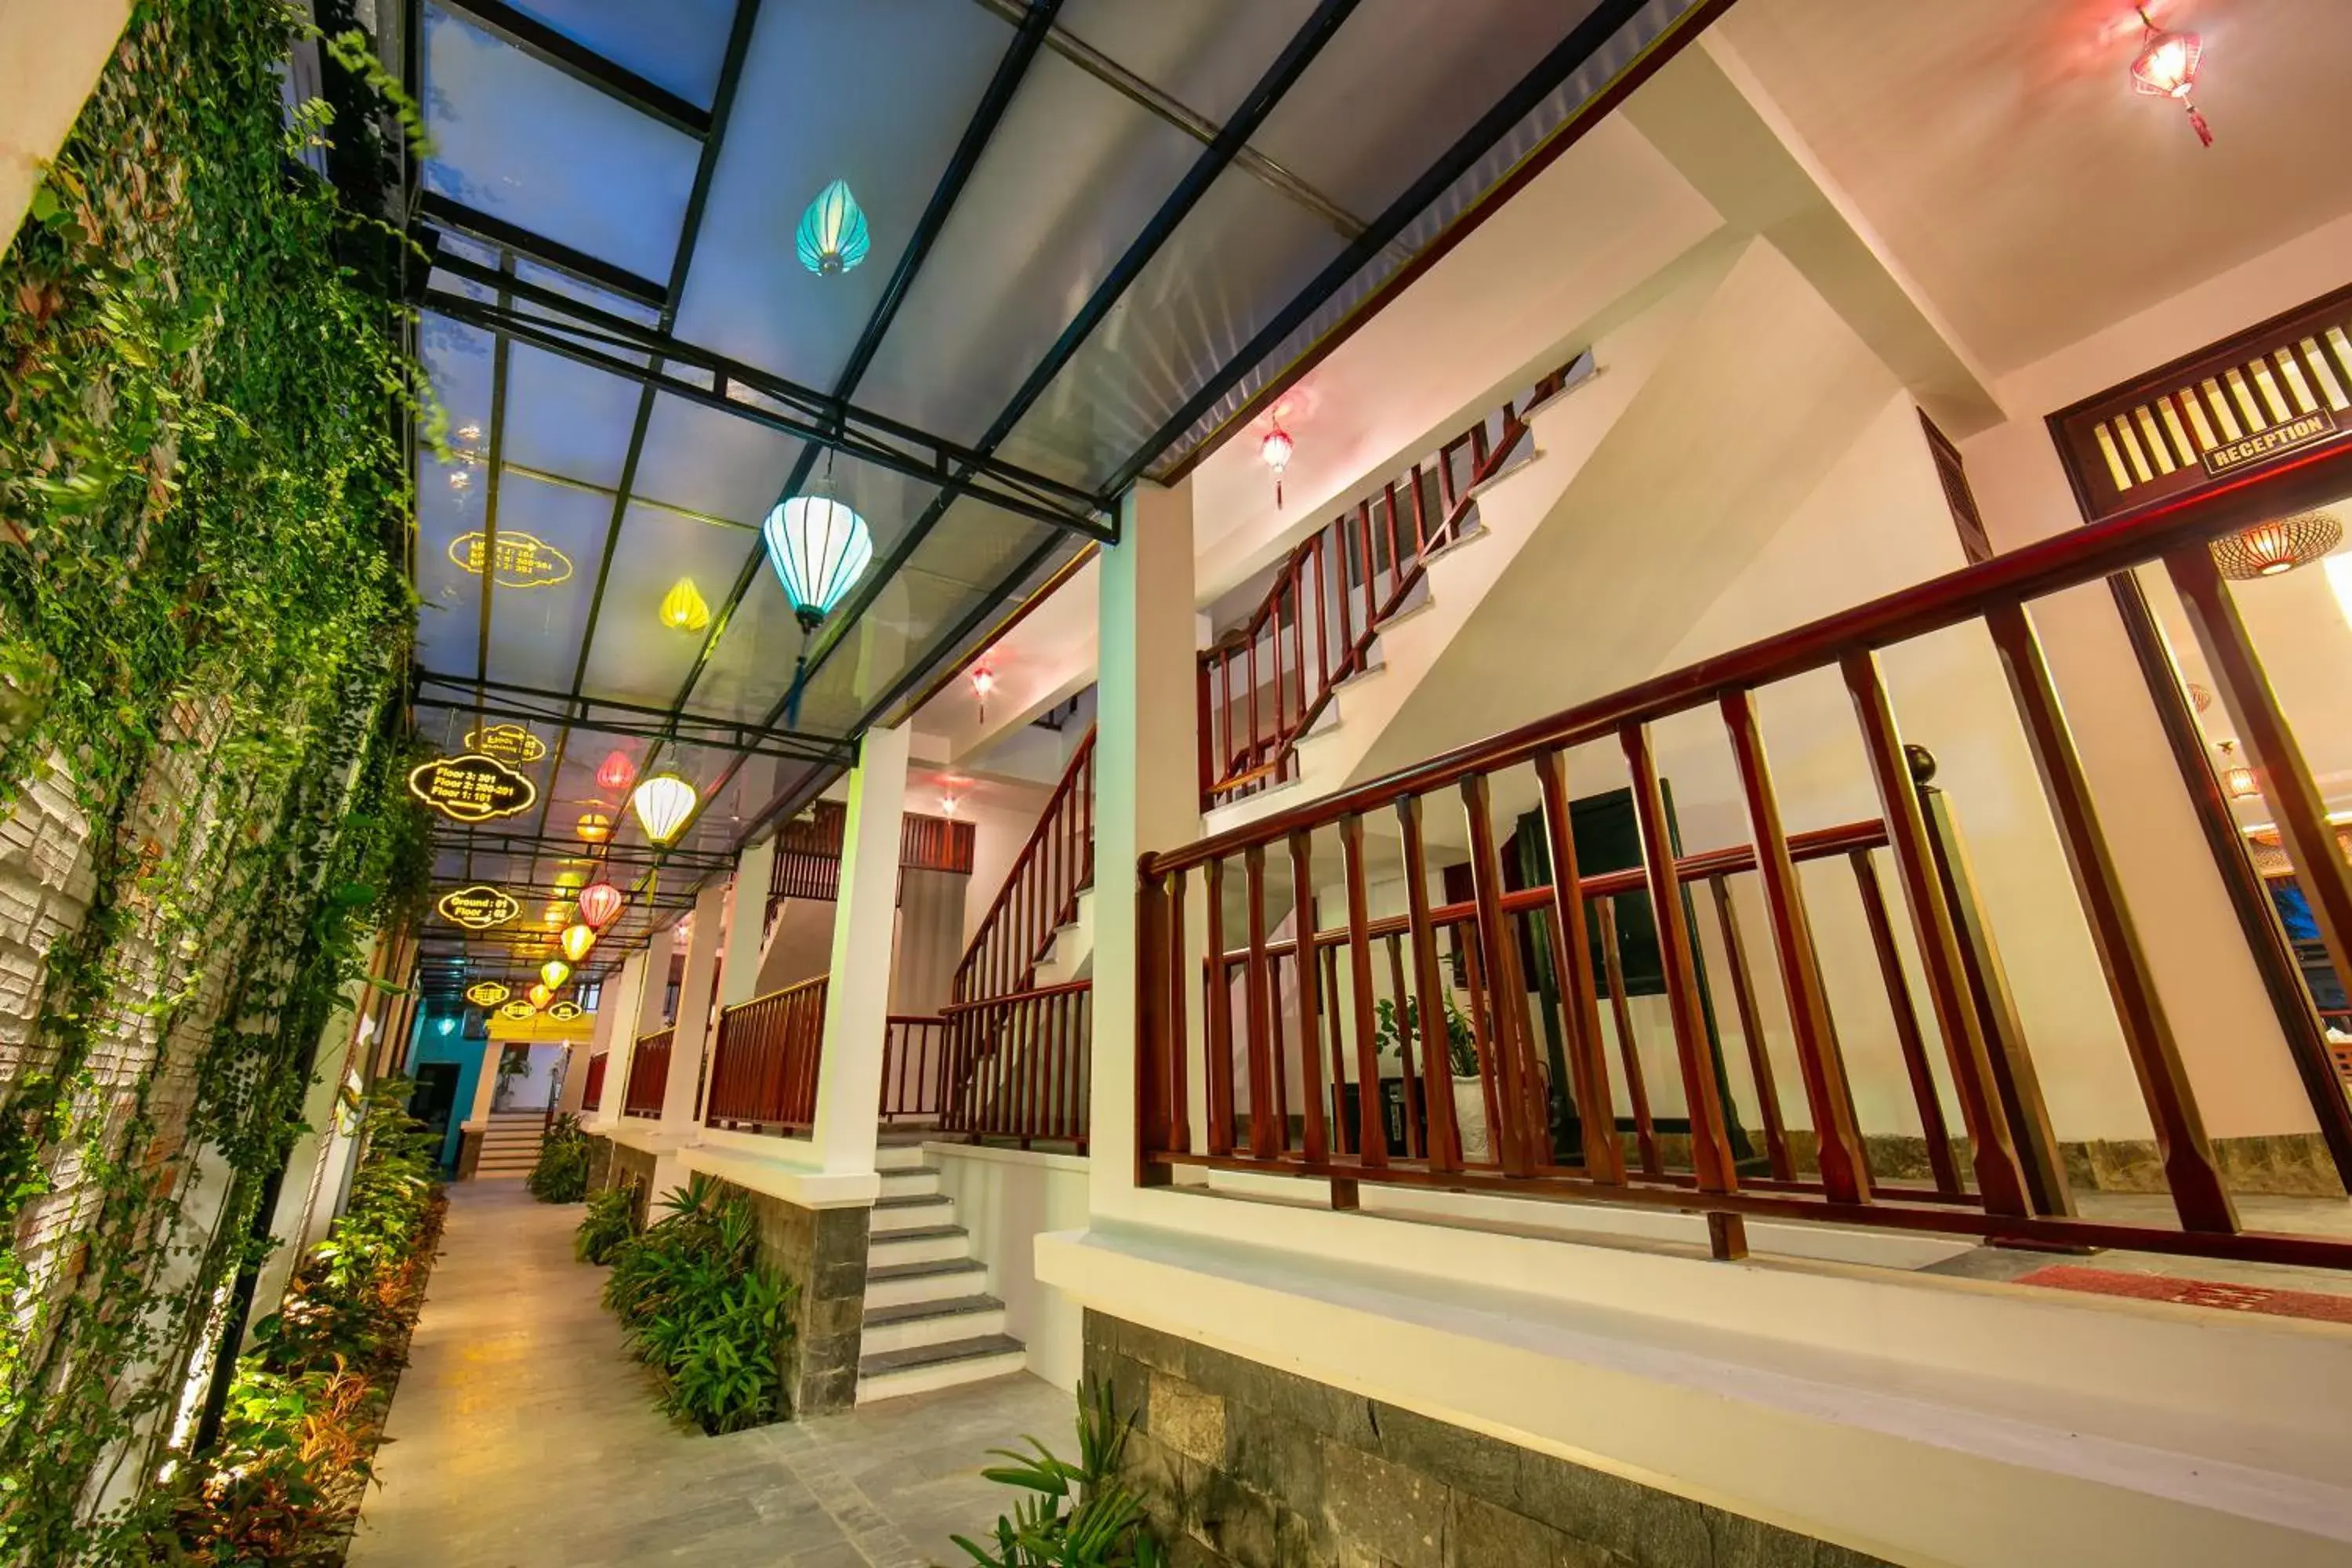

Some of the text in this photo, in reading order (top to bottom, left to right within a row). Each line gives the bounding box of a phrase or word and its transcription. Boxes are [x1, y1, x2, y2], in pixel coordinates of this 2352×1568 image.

[2214, 417, 2324, 467] RECEPTION
[434, 776, 463, 788] Floor
[437, 768, 465, 779] Floor
[478, 774, 496, 784] 301
[431, 786, 459, 797] Floor
[474, 793, 492, 802] 101
[455, 906, 482, 916] Floor
